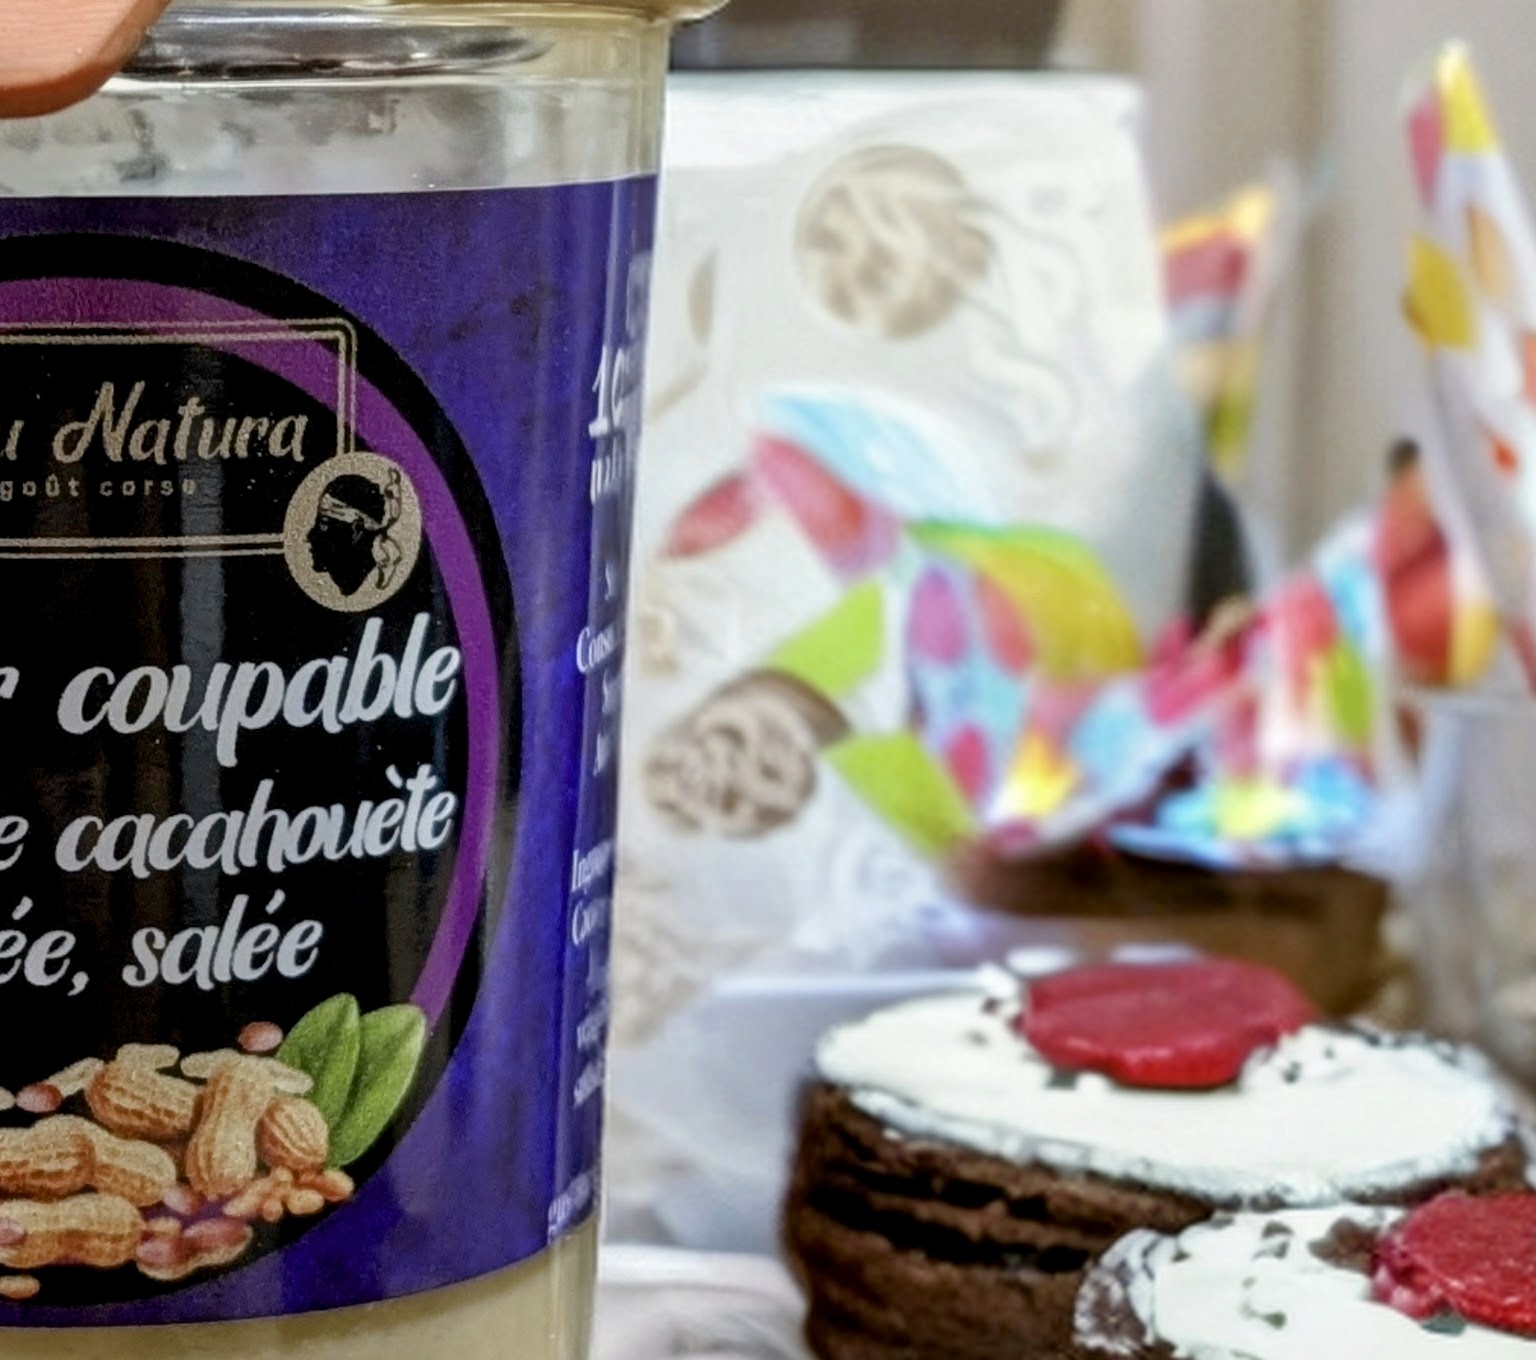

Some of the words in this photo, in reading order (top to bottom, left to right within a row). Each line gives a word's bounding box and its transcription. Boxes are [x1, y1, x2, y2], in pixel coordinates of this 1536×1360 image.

[52, 381, 309, 464] Natura
[0, 473, 79, 501] goût
[57, 612, 461, 767] coupable
[54, 764, 457, 879] cacahouète
[122, 889, 323, 990] salée
